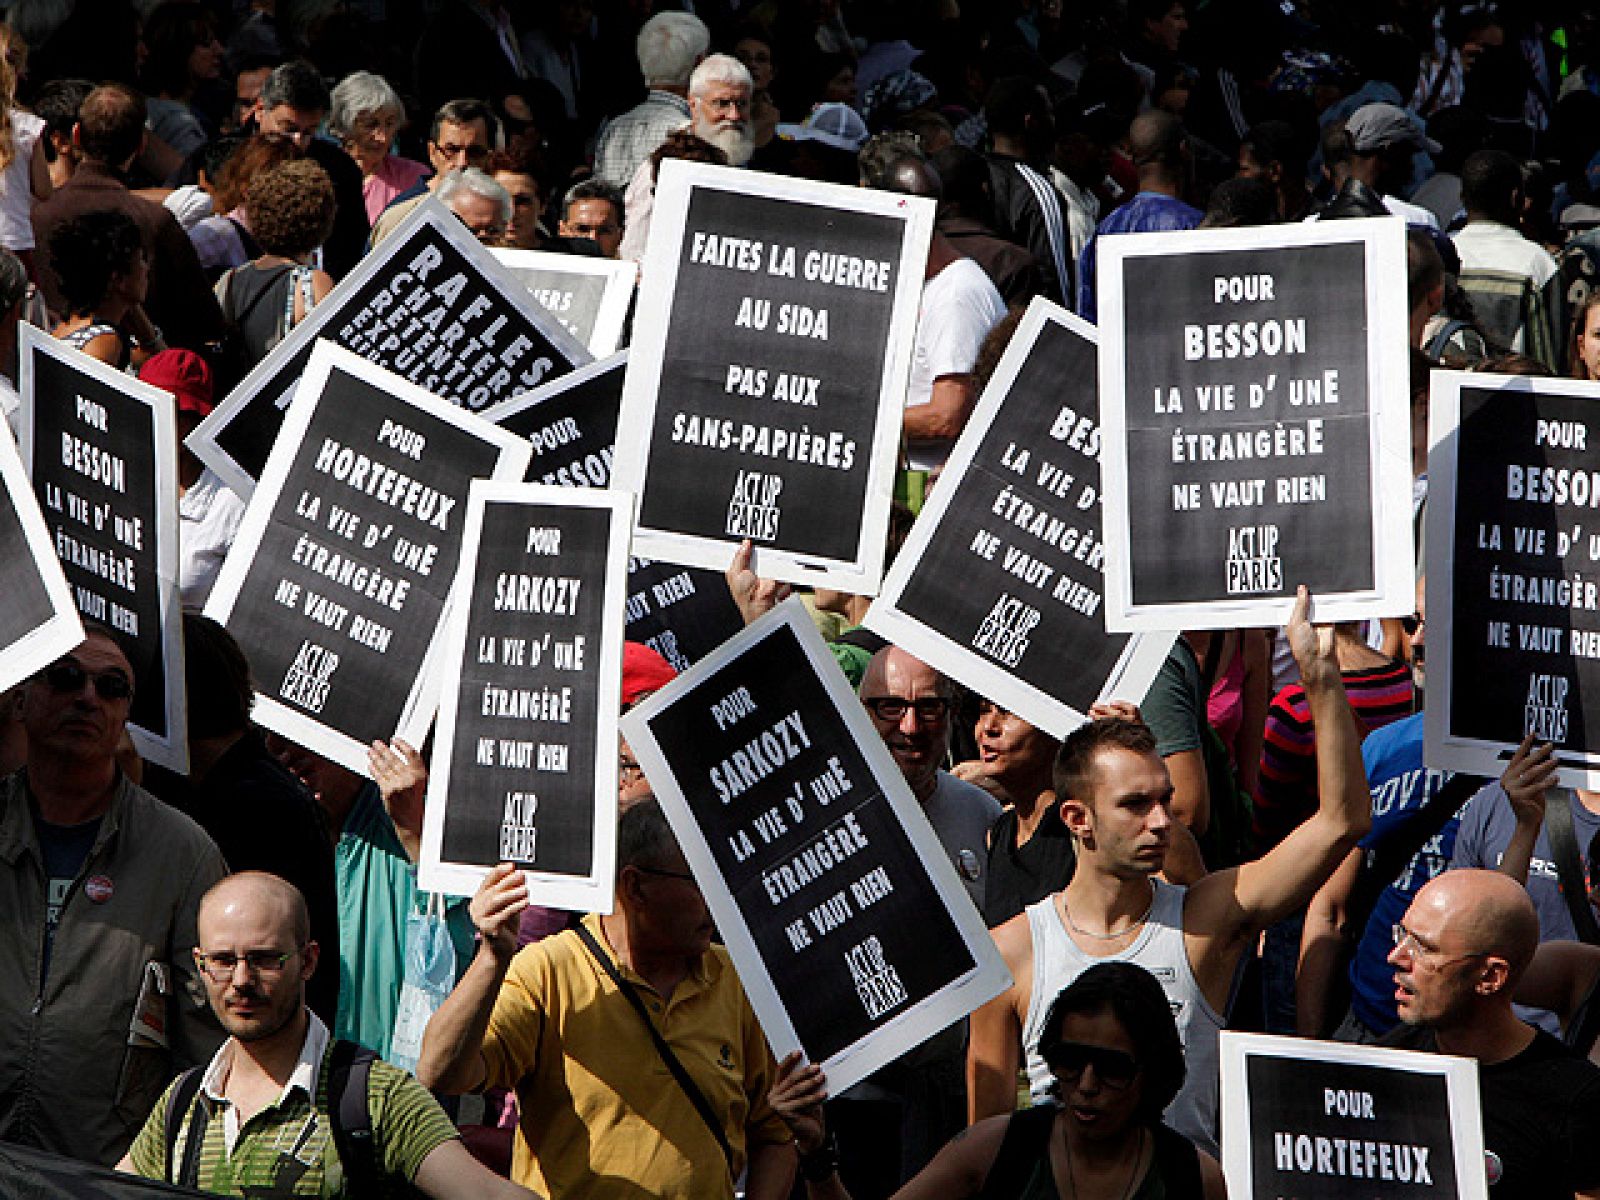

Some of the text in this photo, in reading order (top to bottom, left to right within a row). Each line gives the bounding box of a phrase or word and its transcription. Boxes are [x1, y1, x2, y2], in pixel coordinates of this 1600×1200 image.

[690, 232, 891, 292] FAITES LA GUERRE
[1214, 274, 1275, 303] POUR
[407, 243, 553, 386] RAFLES
[735, 297, 829, 340] AU SIDA
[1184, 319, 1306, 361] BESSON
[725, 365, 820, 405] PAS AUX
[1154, 386, 1183, 413] LA
[1196, 384, 1235, 411] VIE
[1289, 369, 1338, 405] UNE
[75, 394, 109, 433] POUR
[1049, 406, 1101, 461] BES
[1535, 419, 1586, 451] POUR
[376, 418, 427, 460] POUR
[530, 416, 582, 456] POUR
[1172, 419, 1324, 463] ÉTRANGÈRE
[62, 431, 126, 493] BESSON
[314, 437, 456, 531] HORTEFEUX
[1000, 441, 1032, 478] LA
[1036, 461, 1075, 499] VIE
[1172, 474, 1326, 511] NE VAUT RIEN
[46, 481, 63, 514] LA
[67, 493, 89, 527] VIE
[114, 515, 143, 551] UNE
[297, 491, 320, 521] LA
[327, 504, 361, 541] VIE
[392, 537, 439, 577] UNE
[526, 526, 561, 556] POUR
[1478, 522, 1501, 551] LA
[1513, 526, 1546, 556] VIE
[292, 532, 411, 611] ÉTRANGÈRE
[651, 571, 696, 608] RIEN
[969, 529, 1100, 619] NE VAUT RIEN
[1226, 557, 1283, 594] PARIS
[495, 572, 581, 616] SARKOZY
[275, 579, 393, 654] NE VAUT RIEN
[478, 636, 496, 664] LA
[502, 638, 526, 667] VIE
[554, 634, 586, 671] UNE
[1487, 622, 1600, 659] NE VAUT RIE
[482, 682, 571, 723] ÉTRANGÈRE
[709, 686, 759, 731] POUR
[477, 737, 568, 772] NE VAUT RIEN
[709, 709, 812, 804] SARKOZY
[727, 829, 757, 863] LA
[753, 806, 788, 845] VIE
[809, 755, 853, 806] UNE
[761, 812, 869, 905] ÉTRANGÈRE
[784, 866, 894, 953] NE VAUT RIEN
[1324, 1087, 1375, 1120] POUR
[1274, 1132, 1433, 1185] HORTEFEUX
